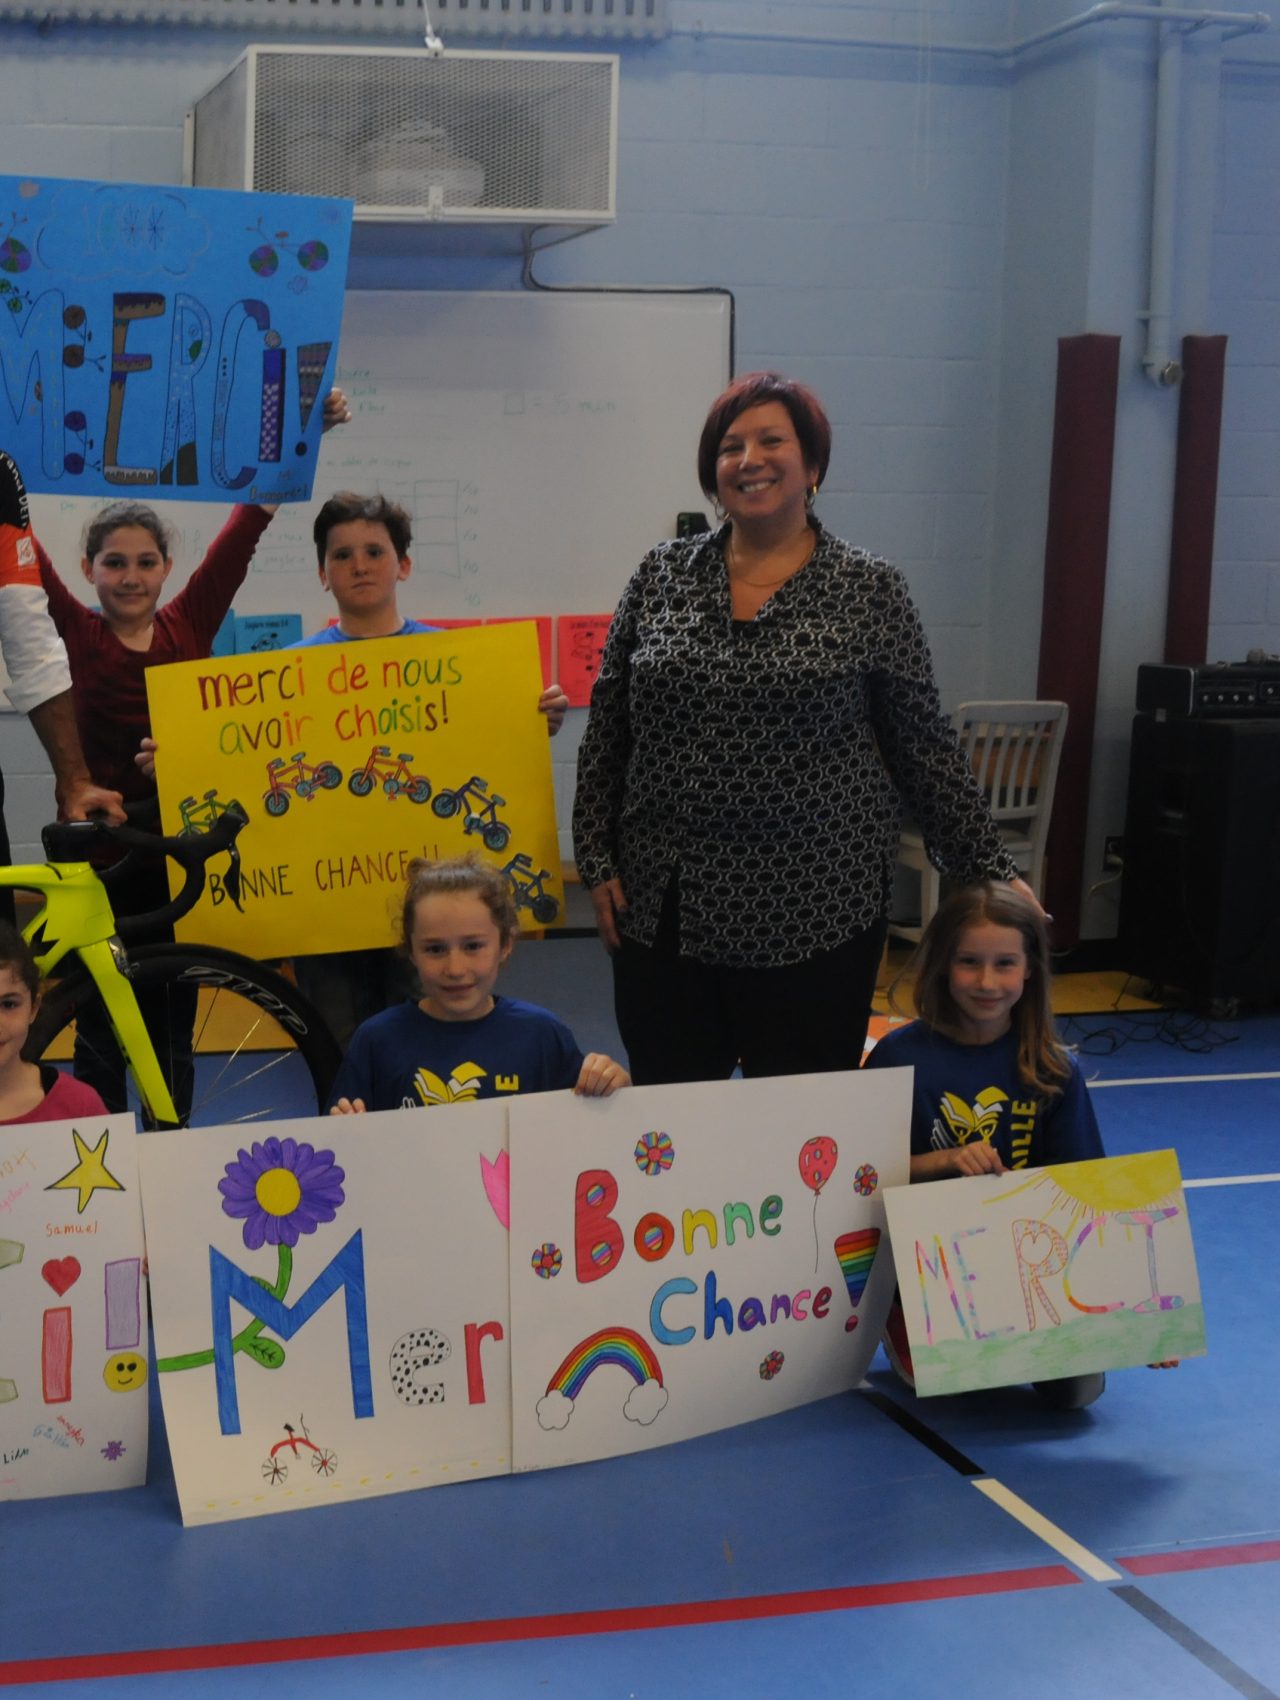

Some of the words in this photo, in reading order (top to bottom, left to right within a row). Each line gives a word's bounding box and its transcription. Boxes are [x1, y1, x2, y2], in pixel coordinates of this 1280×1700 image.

[198, 657, 307, 711] merci
[327, 654, 369, 695] de
[383, 656, 463, 690] nous
[220, 711, 315, 755] avoir
[335, 691, 450, 741] choisis!
[210, 865, 293, 906] BNNE
[575, 1169, 784, 1284] Bonne
[915, 1206, 1185, 1345] MERCI
